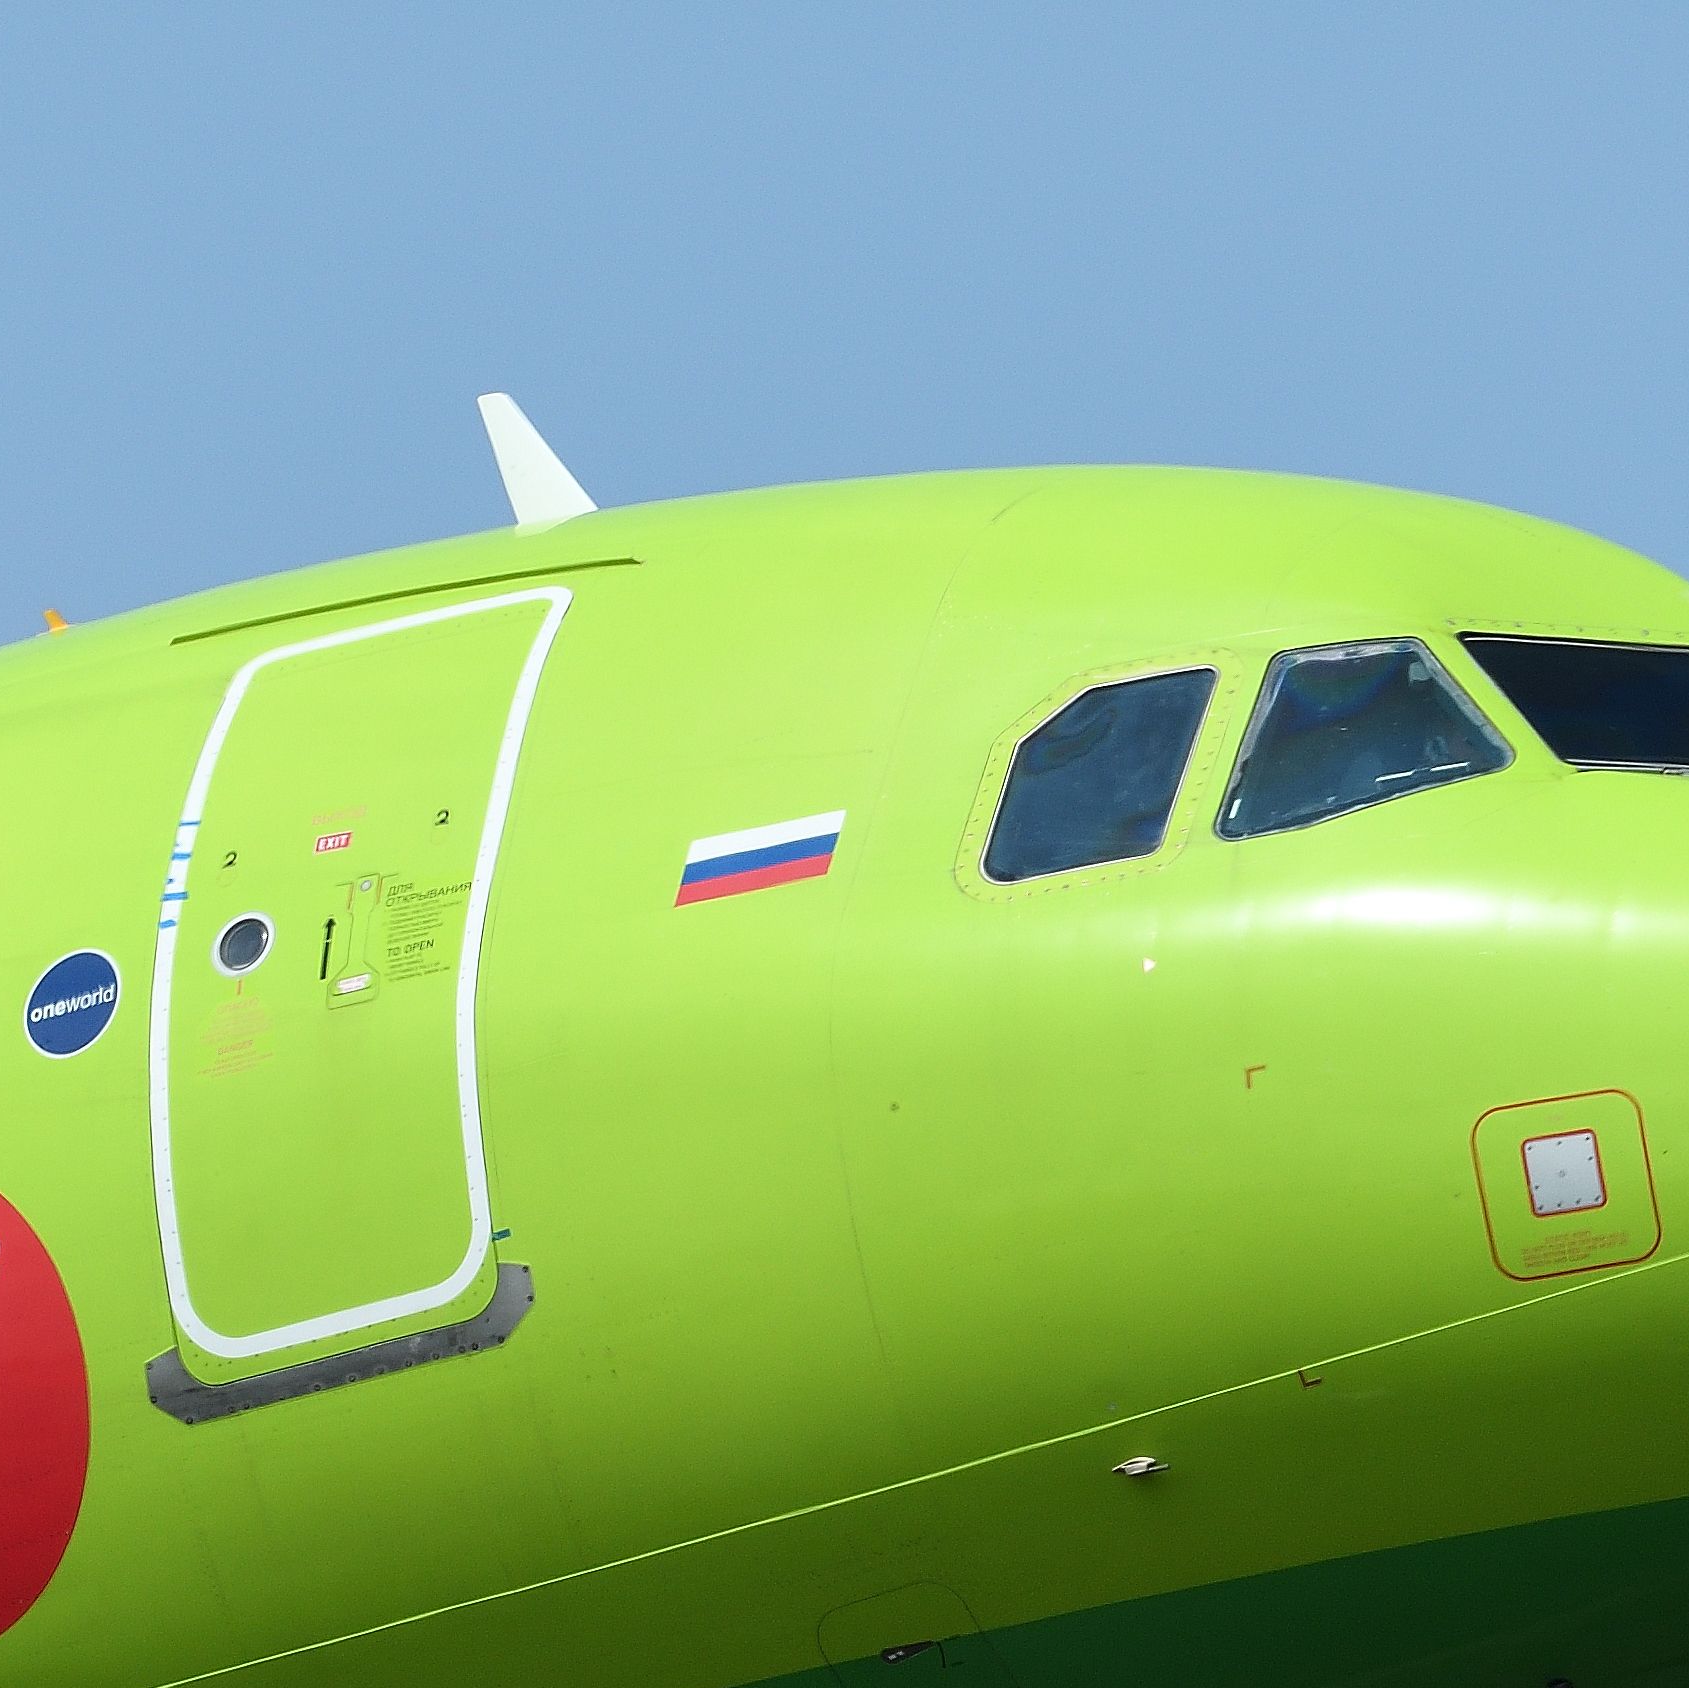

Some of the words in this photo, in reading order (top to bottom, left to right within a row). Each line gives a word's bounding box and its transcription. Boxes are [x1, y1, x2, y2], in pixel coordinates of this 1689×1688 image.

[434, 808, 450, 826] 2
[317, 834, 349, 852] EXIT
[221, 850, 238, 869] 2
[385, 881, 472, 908] ОТКРЫВАНИЯ
[387, 946, 401, 957] TO
[403, 938, 434, 954] OPEN
[30, 983, 115, 1023] oneworld
